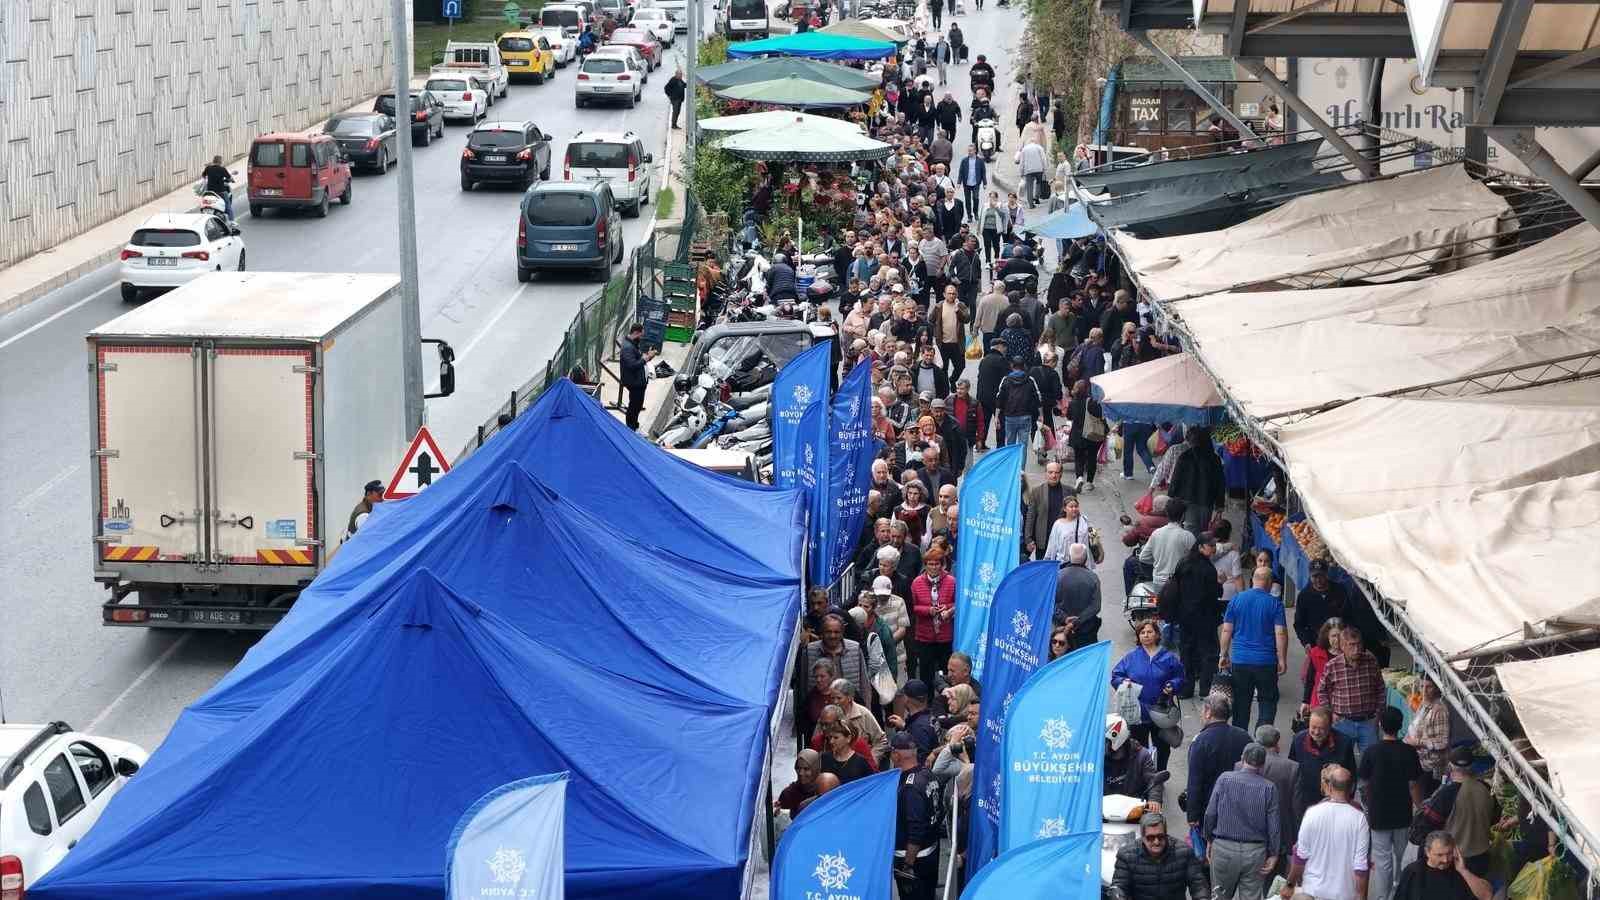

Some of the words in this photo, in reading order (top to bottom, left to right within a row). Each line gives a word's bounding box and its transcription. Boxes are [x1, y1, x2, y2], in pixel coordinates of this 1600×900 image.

[1033, 751, 1048, 760] T.C.
[1051, 751, 1080, 761] AYDIN
[1013, 760, 1095, 774] BÜYÜKŞEHİR
